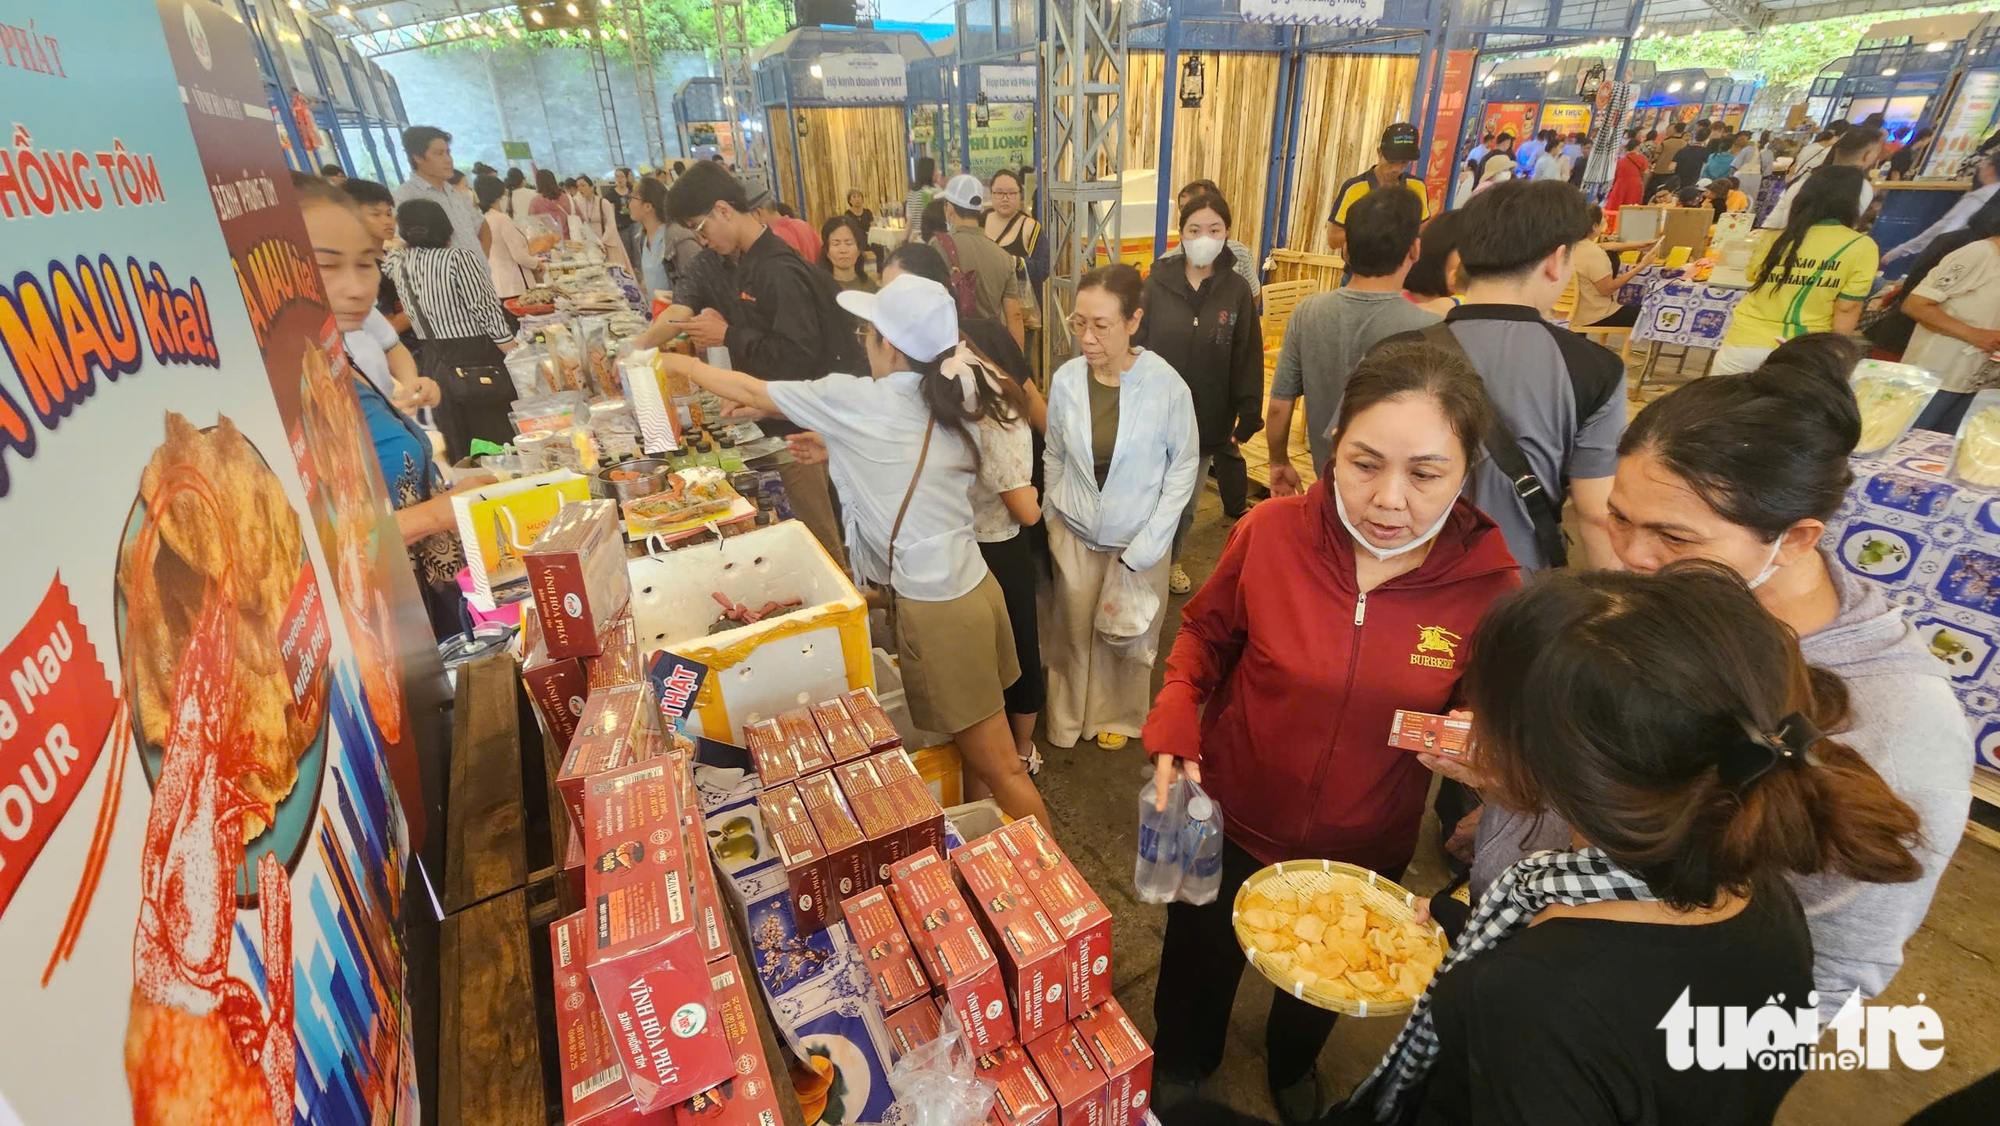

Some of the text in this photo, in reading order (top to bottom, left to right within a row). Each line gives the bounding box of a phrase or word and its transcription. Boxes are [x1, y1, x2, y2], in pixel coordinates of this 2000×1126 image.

[856, 76, 880, 87] doanh
[992, 135, 1027, 149] LONG
[94, 136, 167, 208] TÔM
[129, 260, 218, 364] kia!
[311, 611, 326, 659] PHÍ
[543, 568, 569, 646] VĨNH HÒA PHÁT
[10, 620, 73, 714] Mau
[661, 664, 698, 717] THẬT
[543, 677, 560, 703] VĨNH
[553, 701, 569, 721] HÒA
[730, 995, 740, 1006] 25
[1033, 971, 1045, 1029] VĨNH HÒA PHÁT
[1080, 941, 1091, 1002] VĨNH HÒA PHÁT
[617, 1011, 647, 1069] BÁNH PHỒNG TÔM
[628, 978, 679, 1085] VĨNH HÒA PHÁT
[966, 991, 989, 1045] VĨNH HÒA PHÁT
